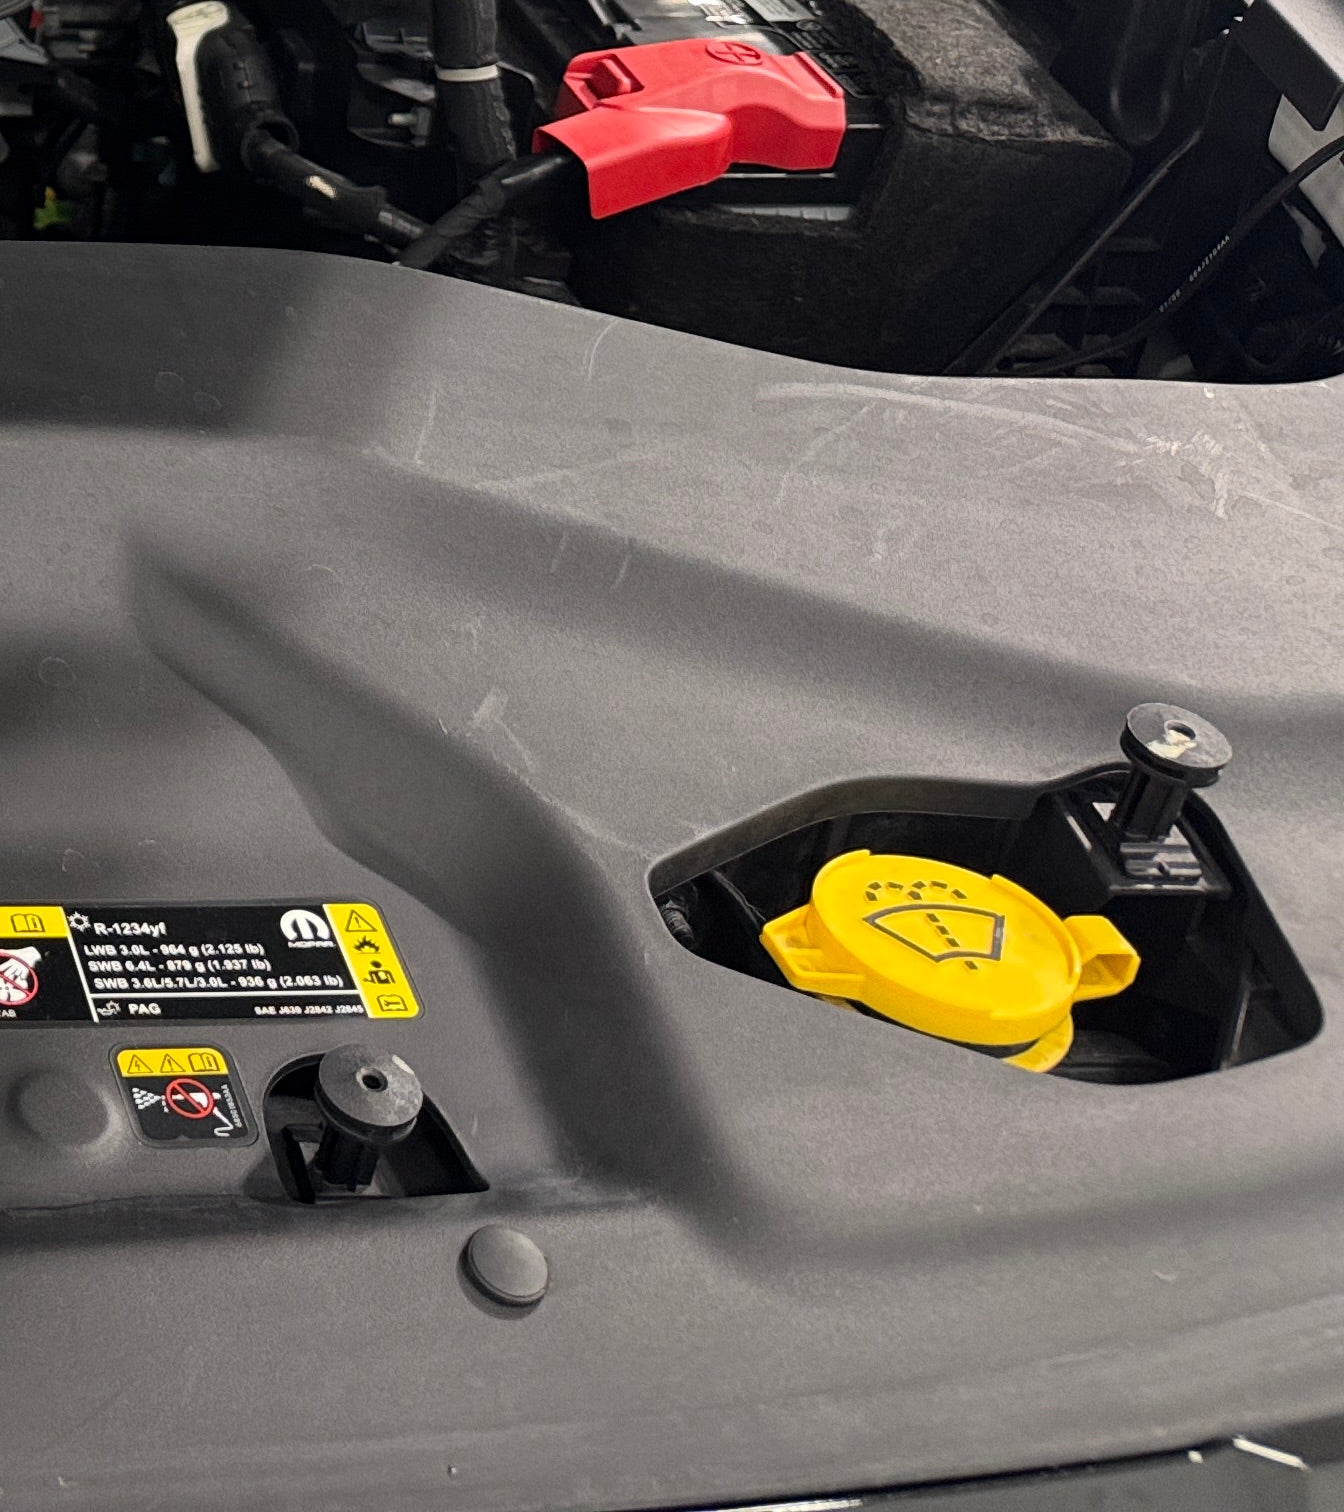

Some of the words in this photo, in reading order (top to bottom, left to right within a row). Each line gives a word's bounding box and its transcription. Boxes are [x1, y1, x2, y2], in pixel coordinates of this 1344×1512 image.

[93, 922, 167, 938] R-1234yf
[83, 944, 117, 956] LWB
[119, 944, 151, 956] 3.0L
[159, 944, 187, 956] 964
[188, 946, 200, 957] g
[200, 943, 244, 956] (2.125
[244, 943, 266, 956] lb)
[88, 960, 123, 972] SWB
[124, 960, 157, 972] 6.4L
[166, 960, 193, 971] 879
[194, 962, 207, 973] g
[207, 959, 249, 972] (1.937
[250, 959, 272, 972] lb)
[93, 977, 130, 989] SWB
[131, 976, 229, 988] 3.6L/5.7L/3.0L
[238, 976, 265, 988] 936
[266, 978, 278, 989] g
[279, 975, 322, 988] (2.063
[323, 975, 344, 988] lb)
[128, 1003, 162, 1015] PAG
[254, 1006, 277, 1015] SAE
